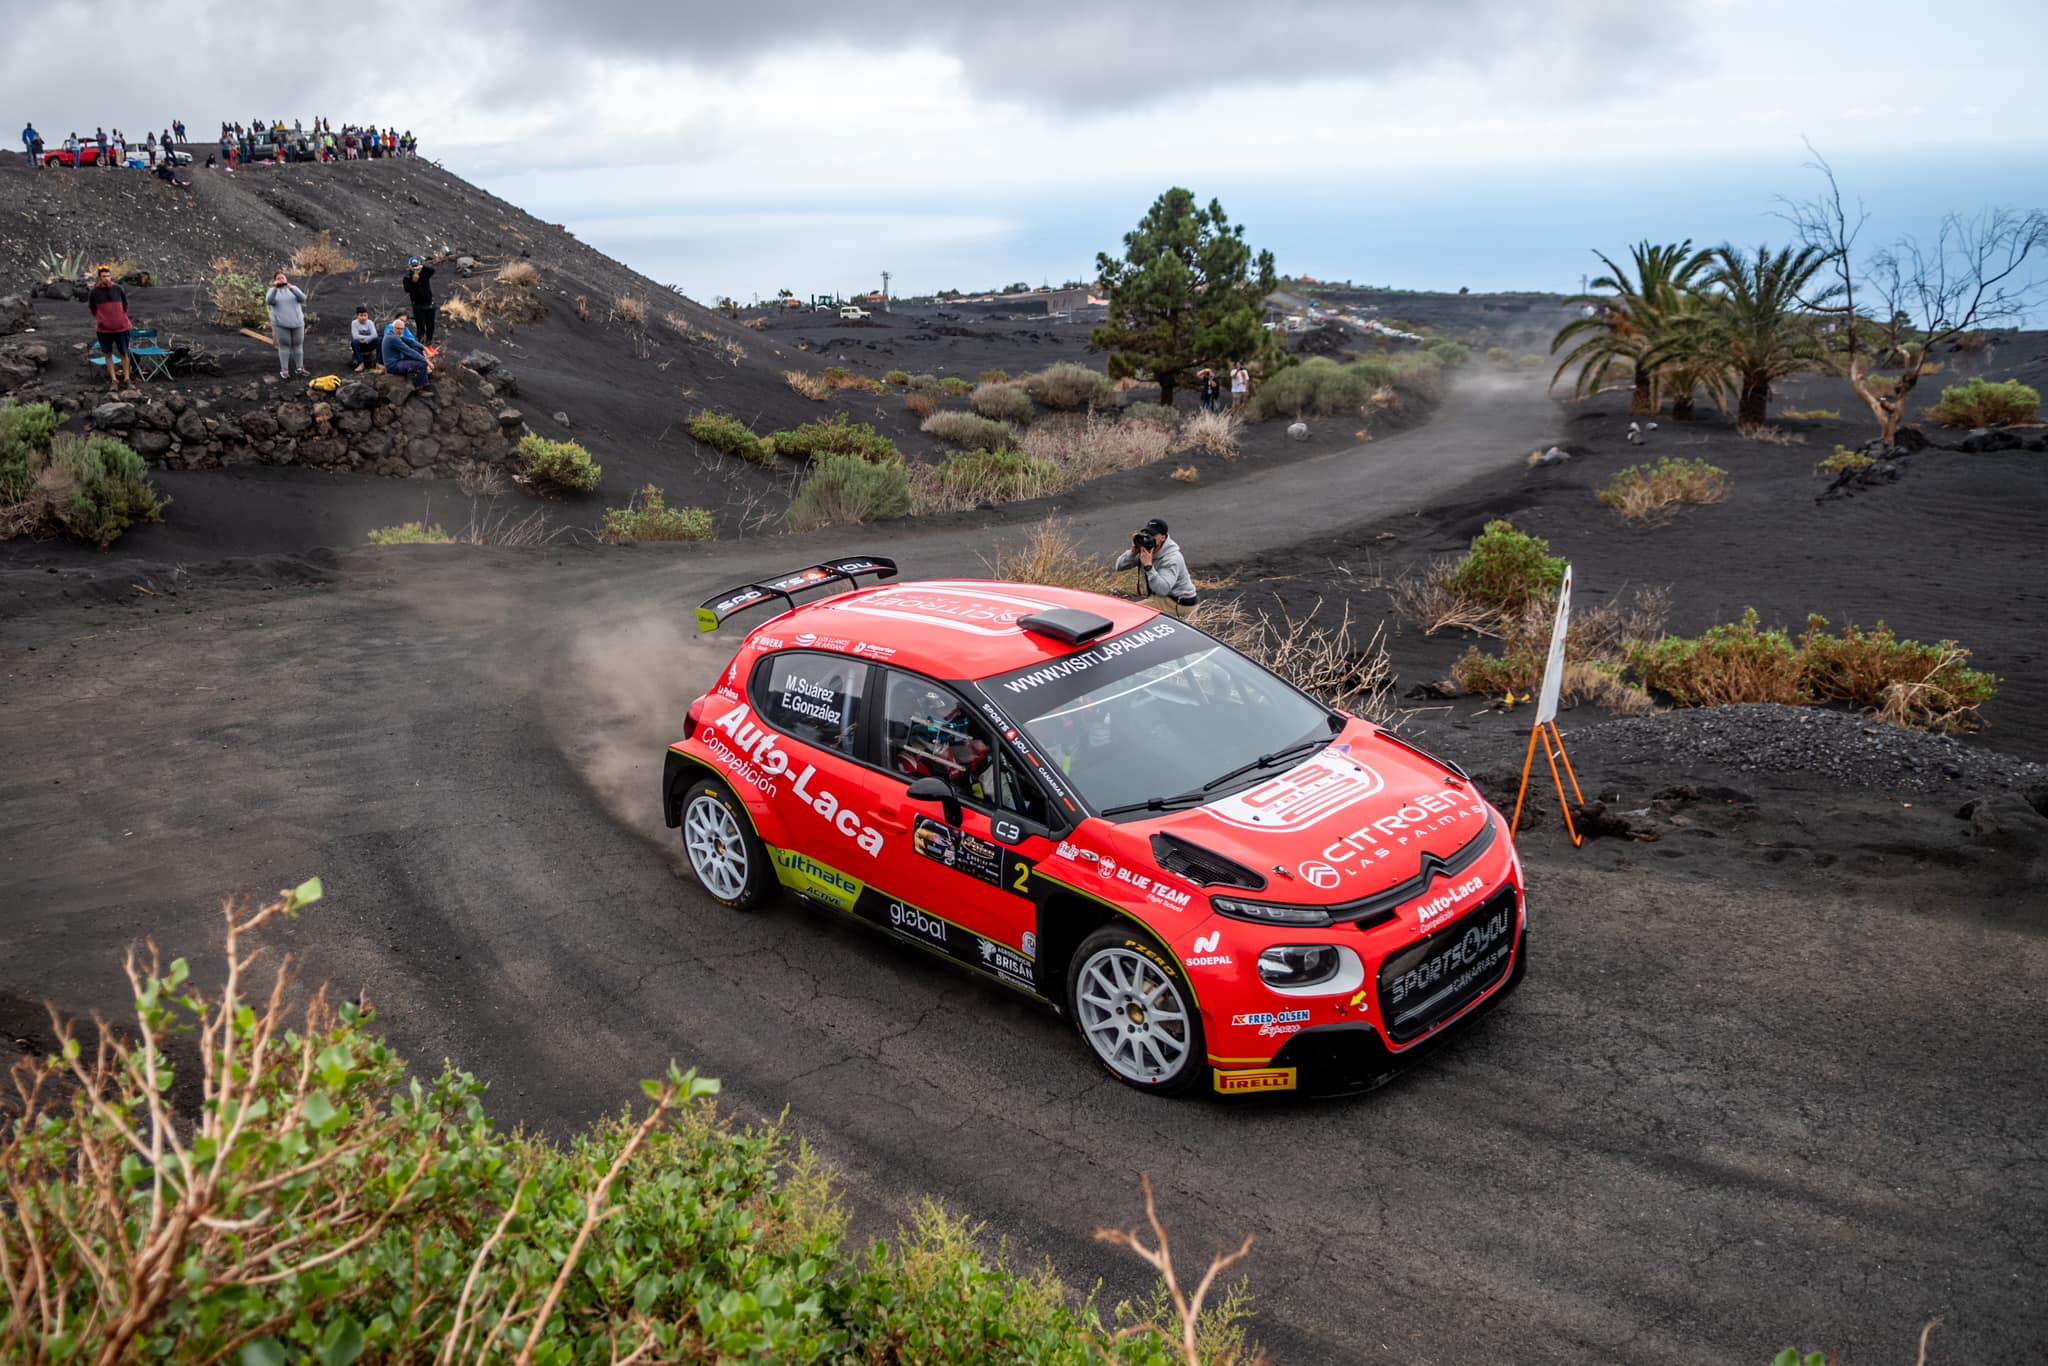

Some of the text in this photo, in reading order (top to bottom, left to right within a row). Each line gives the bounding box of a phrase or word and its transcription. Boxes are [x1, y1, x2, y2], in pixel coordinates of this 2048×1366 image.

[785, 674, 834, 703] M.Suárez
[781, 692, 841, 725] E.González
[702, 727, 776, 798] Competición
[715, 702, 884, 858] Auto-Laca
[1039, 767, 1065, 797] CANARIAS
[996, 820, 1020, 840] C3
[1323, 789, 1470, 862] CITROËN
[1345, 805, 1482, 876] LAS PALMAS
[1013, 862, 1030, 893] 2
[1116, 867, 1192, 907] BLUE TEAM
[1417, 876, 1483, 922] Auto-Laca
[890, 901, 946, 941] global
[996, 953, 1033, 980] BRISÁN
[1185, 955, 1232, 967] SODEPAL
[1452, 952, 1498, 992] CANARIAS
[1248, 1010, 1309, 1024] FRED. OLSEN
[1219, 1072, 1289, 1089] PIRELLI
